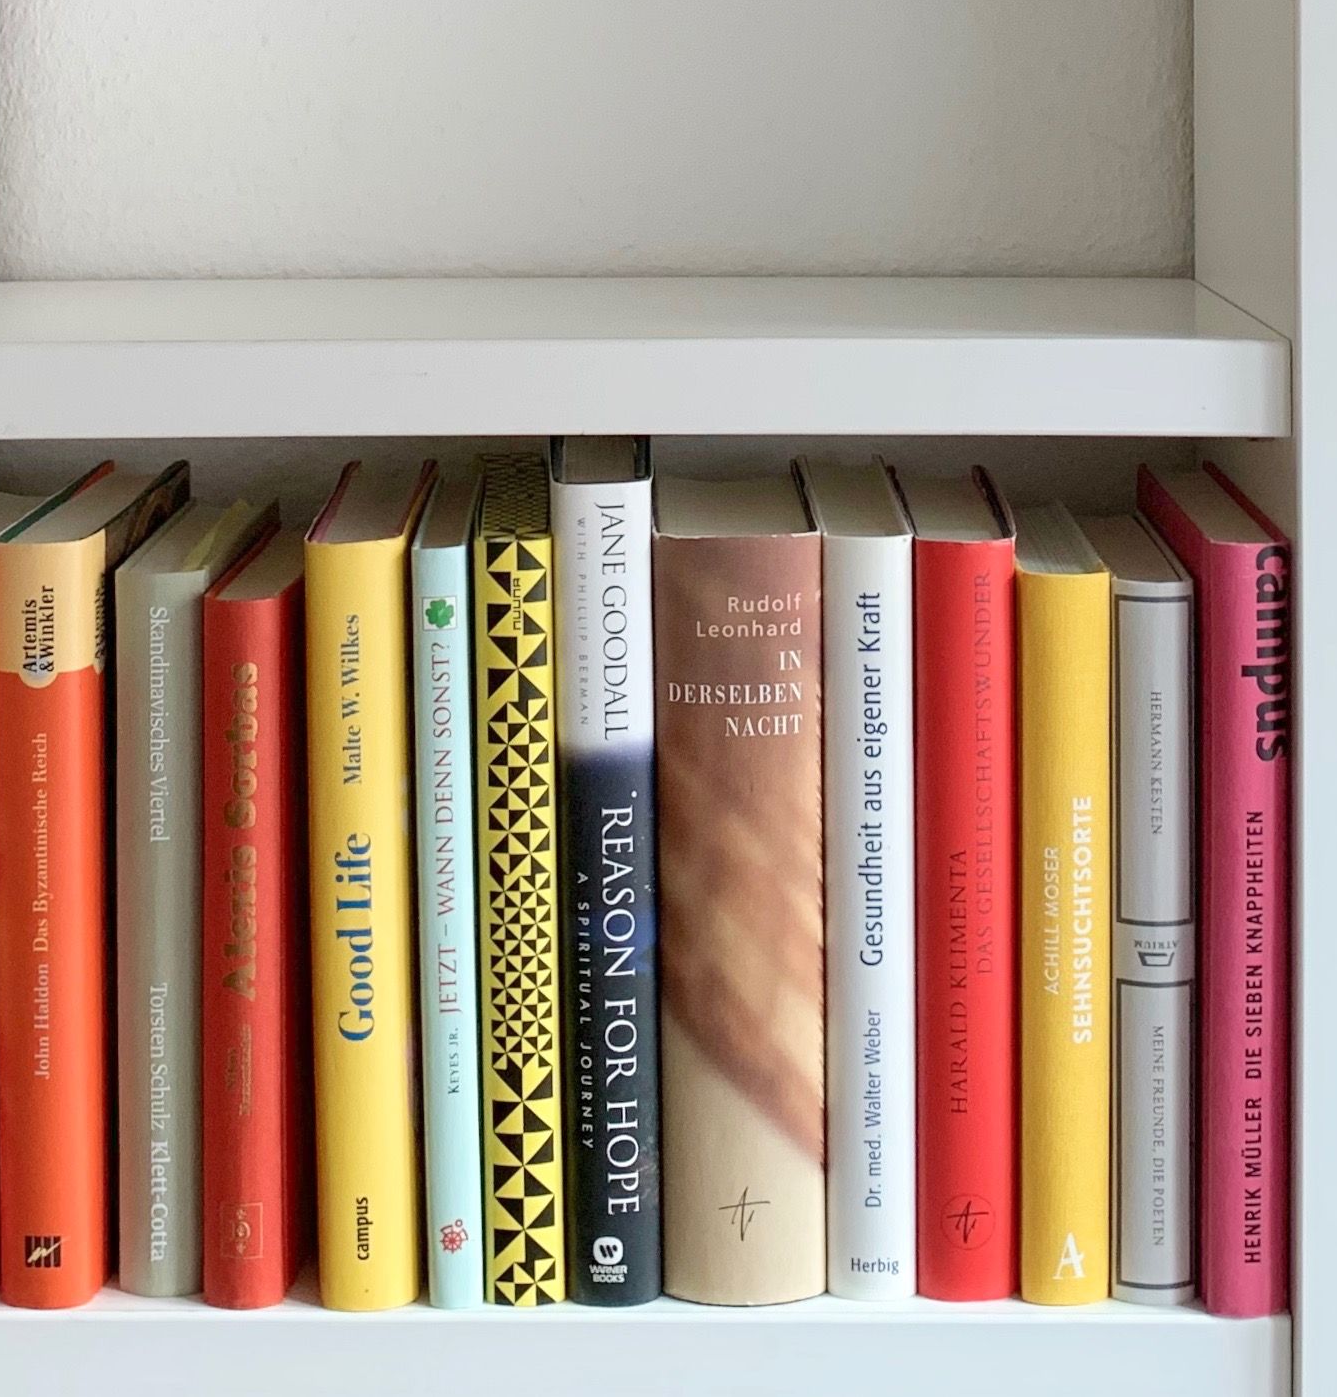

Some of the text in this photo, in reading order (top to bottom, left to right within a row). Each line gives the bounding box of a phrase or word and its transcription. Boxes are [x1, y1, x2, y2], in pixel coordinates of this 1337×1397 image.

[727, 595, 802, 614] Rudolf
[595, 502, 631, 740] JANE GOODALL
[696, 619, 802, 641] Leonhard
[779, 651, 802, 670] IN
[668, 683, 802, 704] DERSELBEN
[725, 714, 802, 734] NACHT
[1072, 795, 1092, 1044] SEHNSUCHTSORTE
[335, 832, 374, 1042] Good Life
[602, 804, 640, 1215] REASON FOR HOPE
[357, 1197, 368, 1262] campus
[850, 1256, 898, 1275] Herbig
